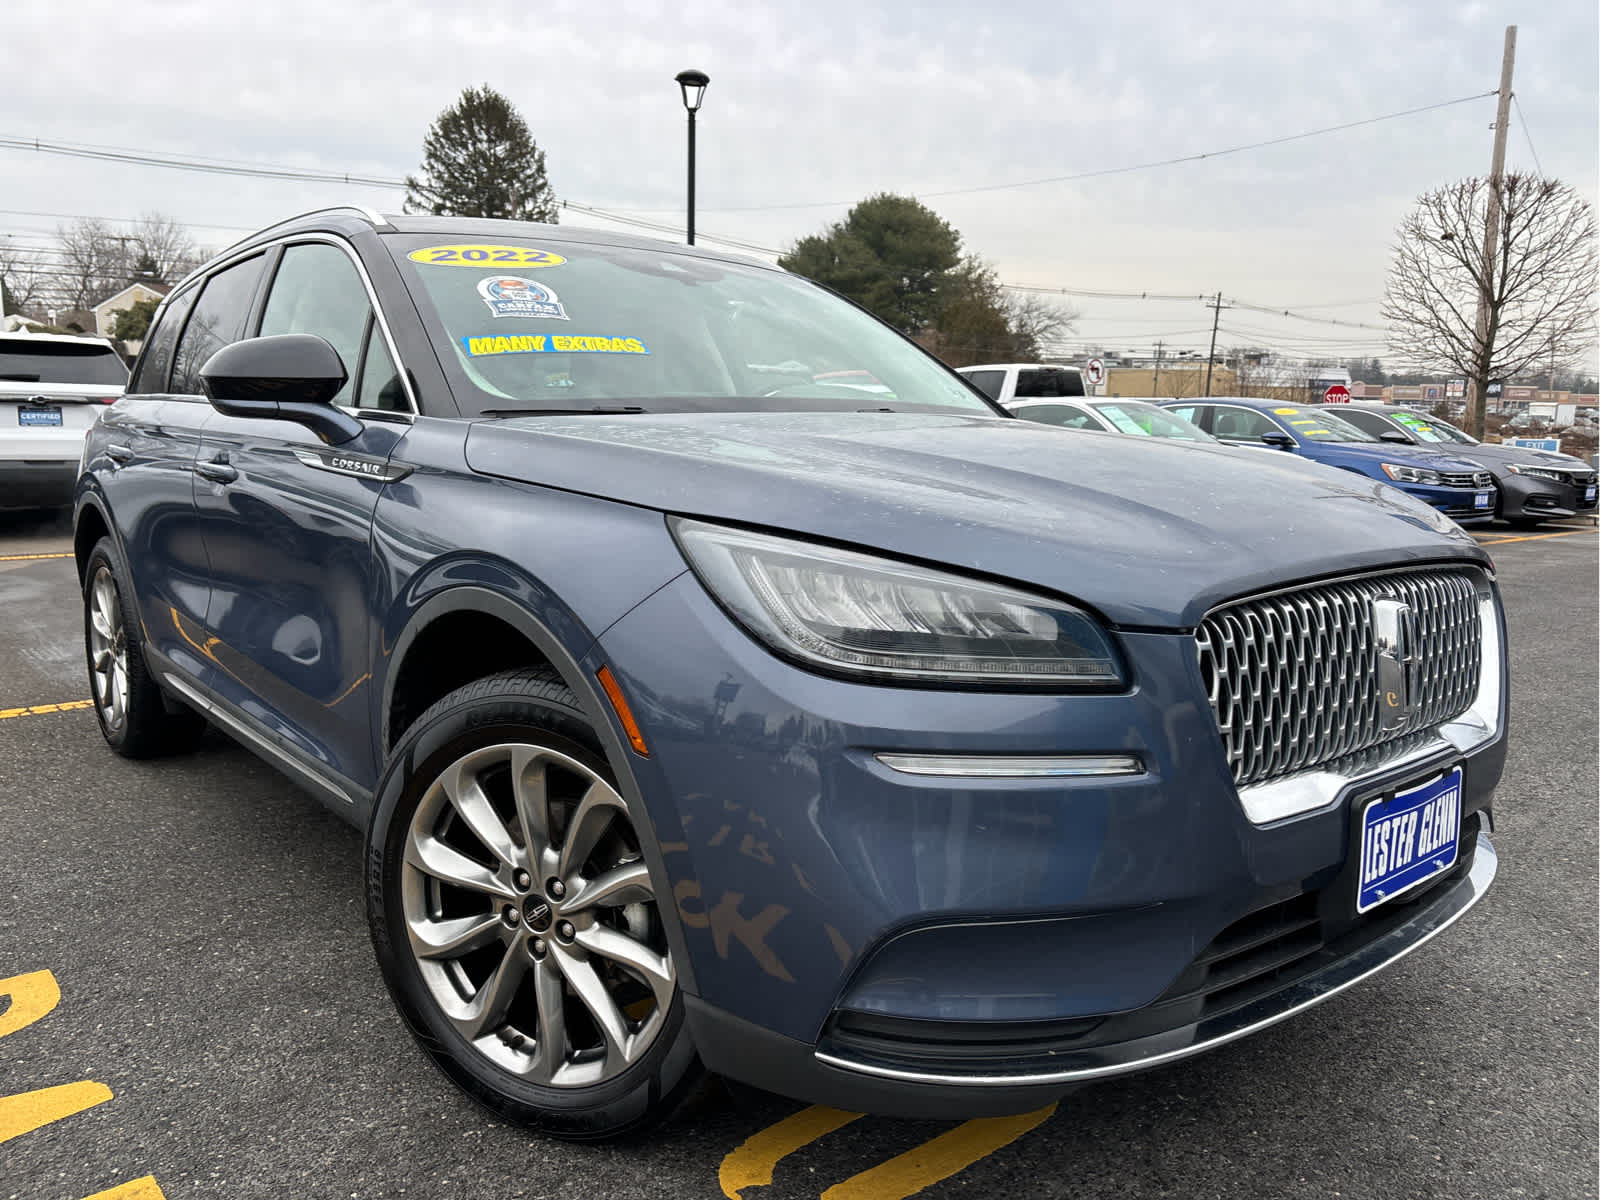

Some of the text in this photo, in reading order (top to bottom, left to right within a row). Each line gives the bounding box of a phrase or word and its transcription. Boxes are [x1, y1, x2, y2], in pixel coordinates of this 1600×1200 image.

[430, 249, 551, 263] 2022
[468, 335, 547, 355] MANY
[1326, 393, 1349, 404] STOP
[20, 412, 61, 420] CERTIFIED
[1526, 441, 1545, 449] EXIT
[331, 457, 380, 474] CORSAIR
[1364, 789, 1458, 884] LESTER GLENN
